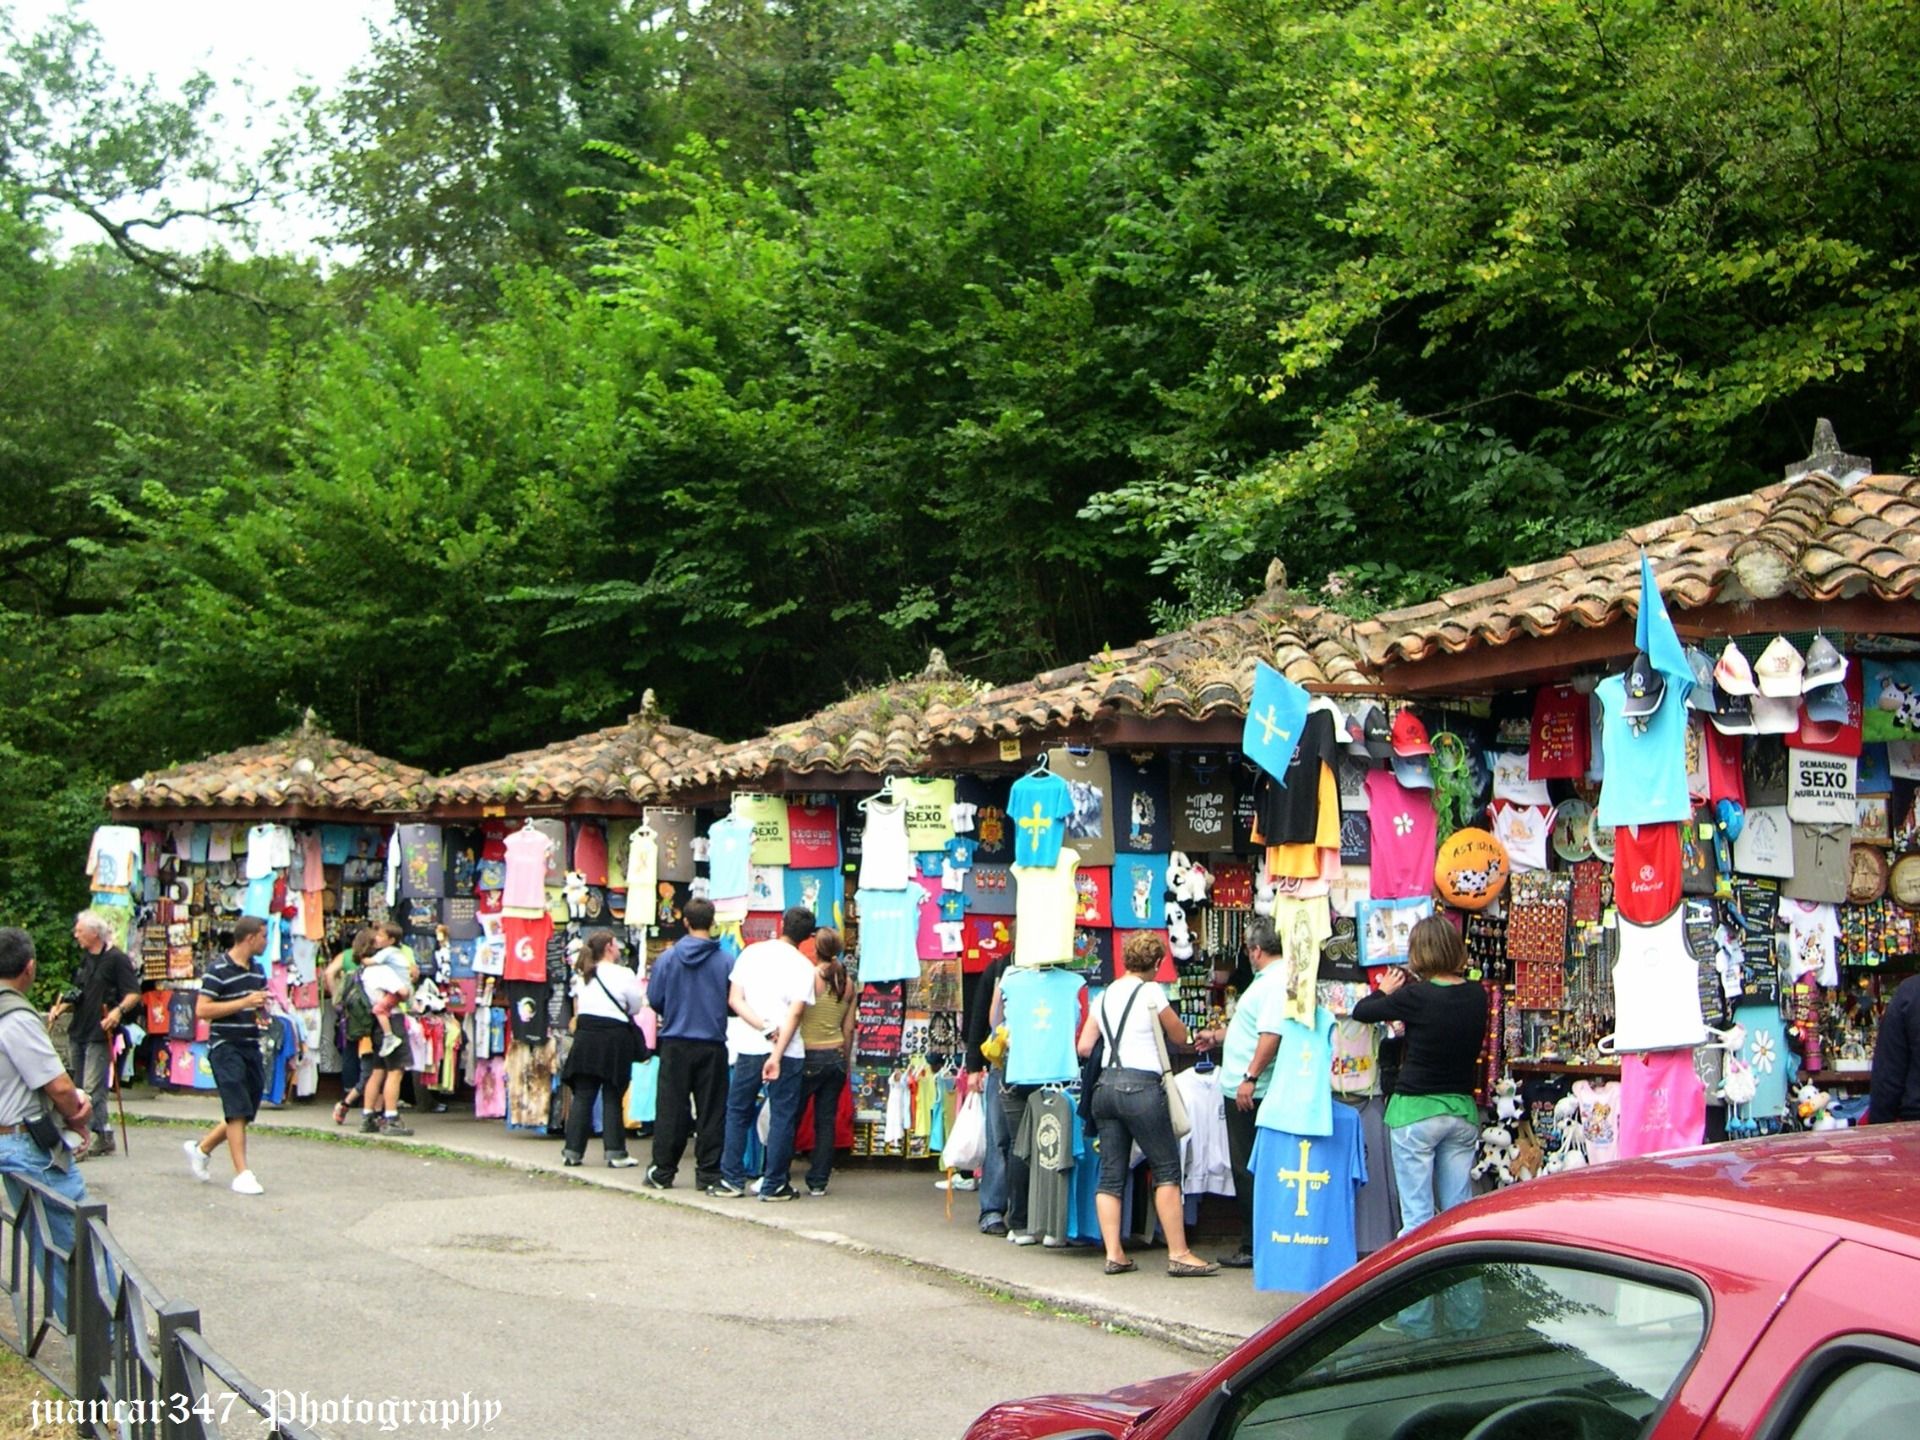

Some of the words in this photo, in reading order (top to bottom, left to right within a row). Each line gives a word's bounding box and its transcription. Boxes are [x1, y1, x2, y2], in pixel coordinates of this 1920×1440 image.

[1799, 761, 1847, 770] DEMASIADO
[1800, 770, 1847, 789] SEXO
[1794, 790, 1821, 798] NUBLA
[1822, 790, 1833, 798] LA
[1834, 791, 1855, 800] VISTA
[906, 811, 941, 822] SEXO
[1188, 817, 1222, 834] TOCA
[752, 827, 779, 836] SEXO
